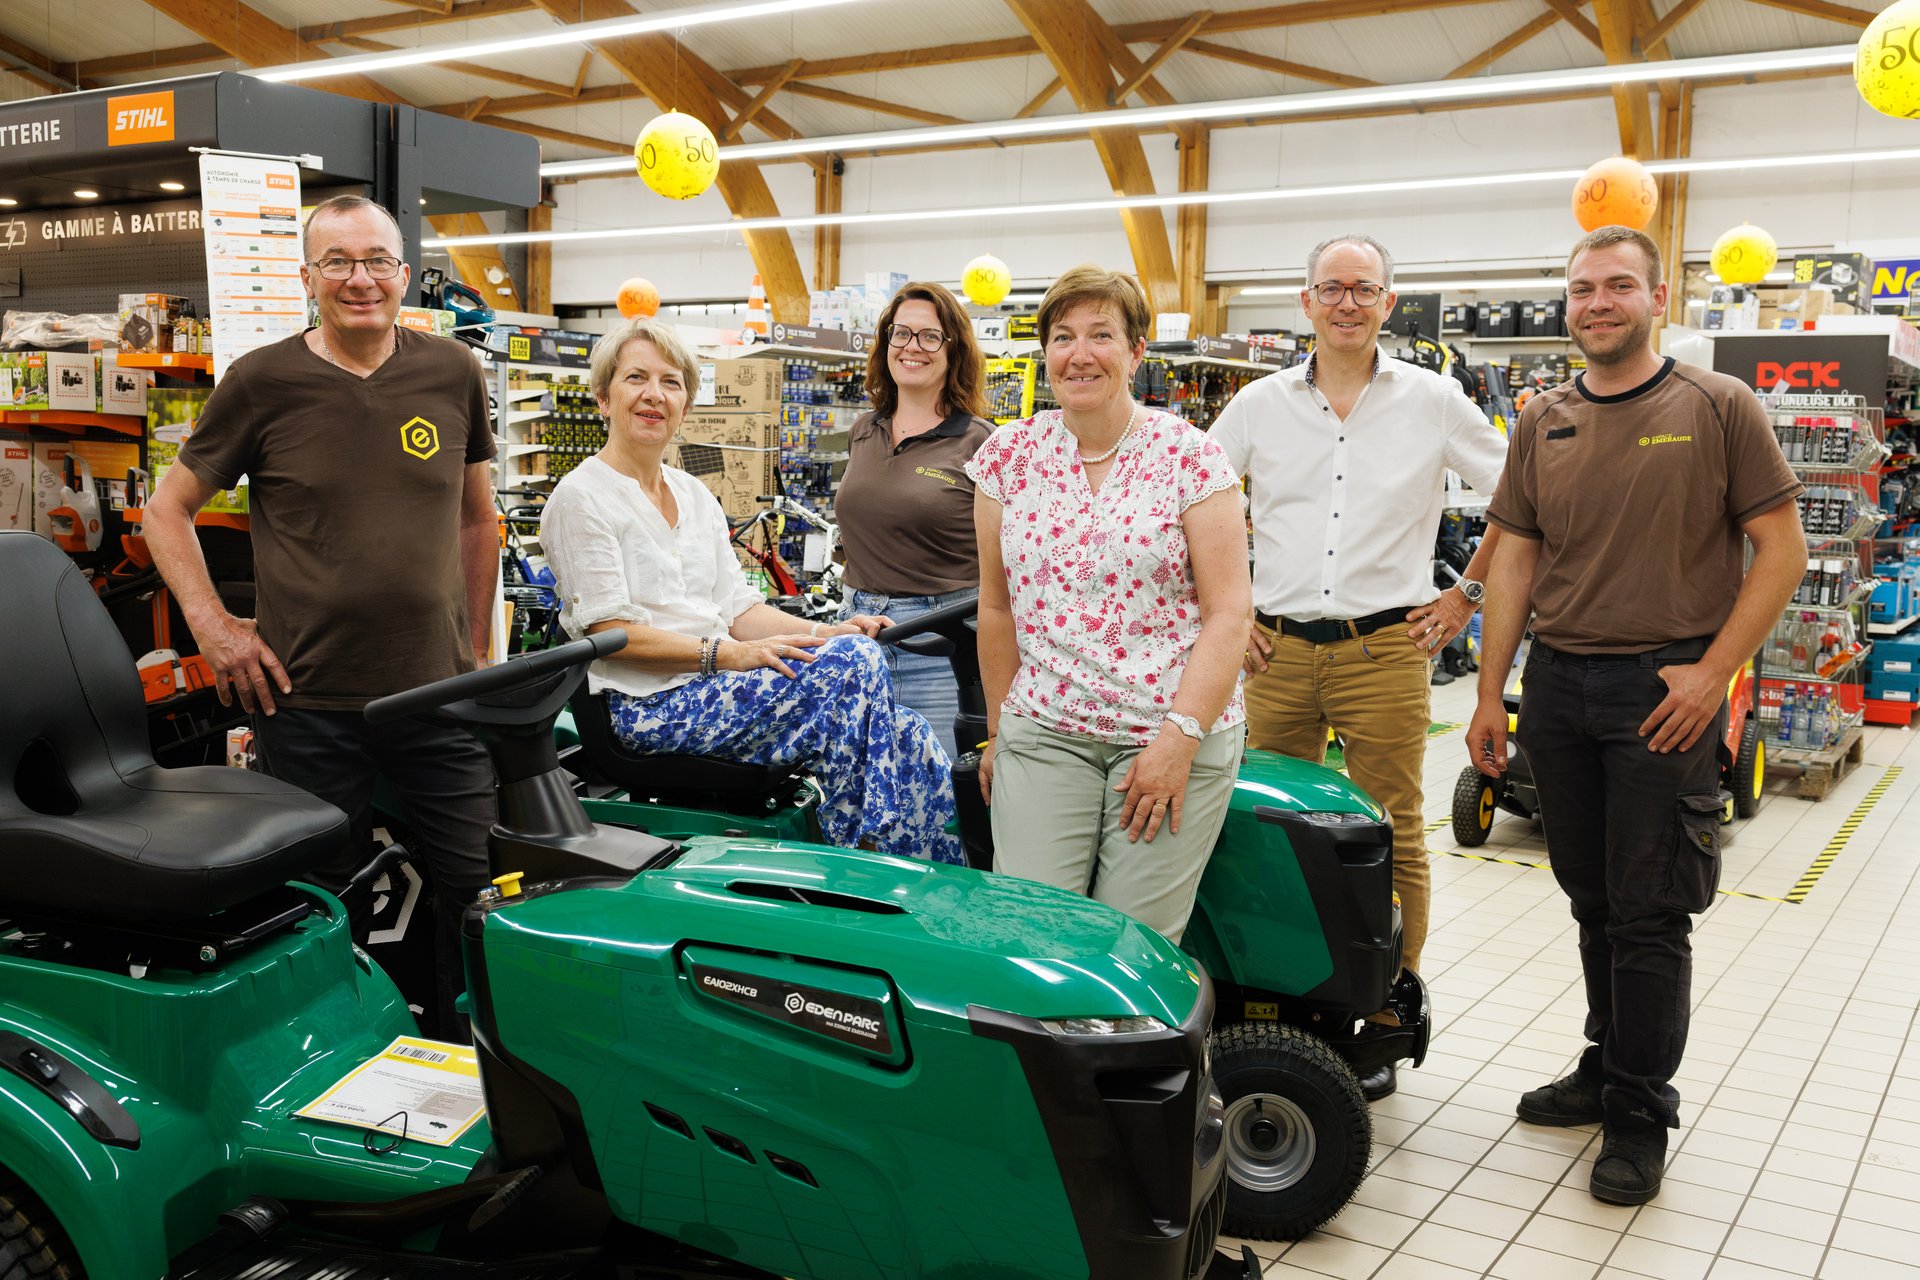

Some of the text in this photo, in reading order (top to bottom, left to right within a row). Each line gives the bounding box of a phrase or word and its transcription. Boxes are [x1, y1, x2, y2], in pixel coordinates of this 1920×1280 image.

[115, 107, 167, 131] STIHL
[685, 136, 714, 163] 50
[269, 177, 293, 187] STIHL
[41, 217, 105, 240] GAMME
[112, 211, 124, 235] À
[1720, 247, 1742, 265] 50
[976, 268, 995, 284] 50
[403, 316, 429, 327] STIHL
[512, 340, 528, 350] STAR
[512, 349, 528, 358] BLOCK
[1756, 361, 1840, 388] DCK
[1651, 436, 1692, 445] EMERAUDE
[924, 471, 957, 486] EMERAUDE
